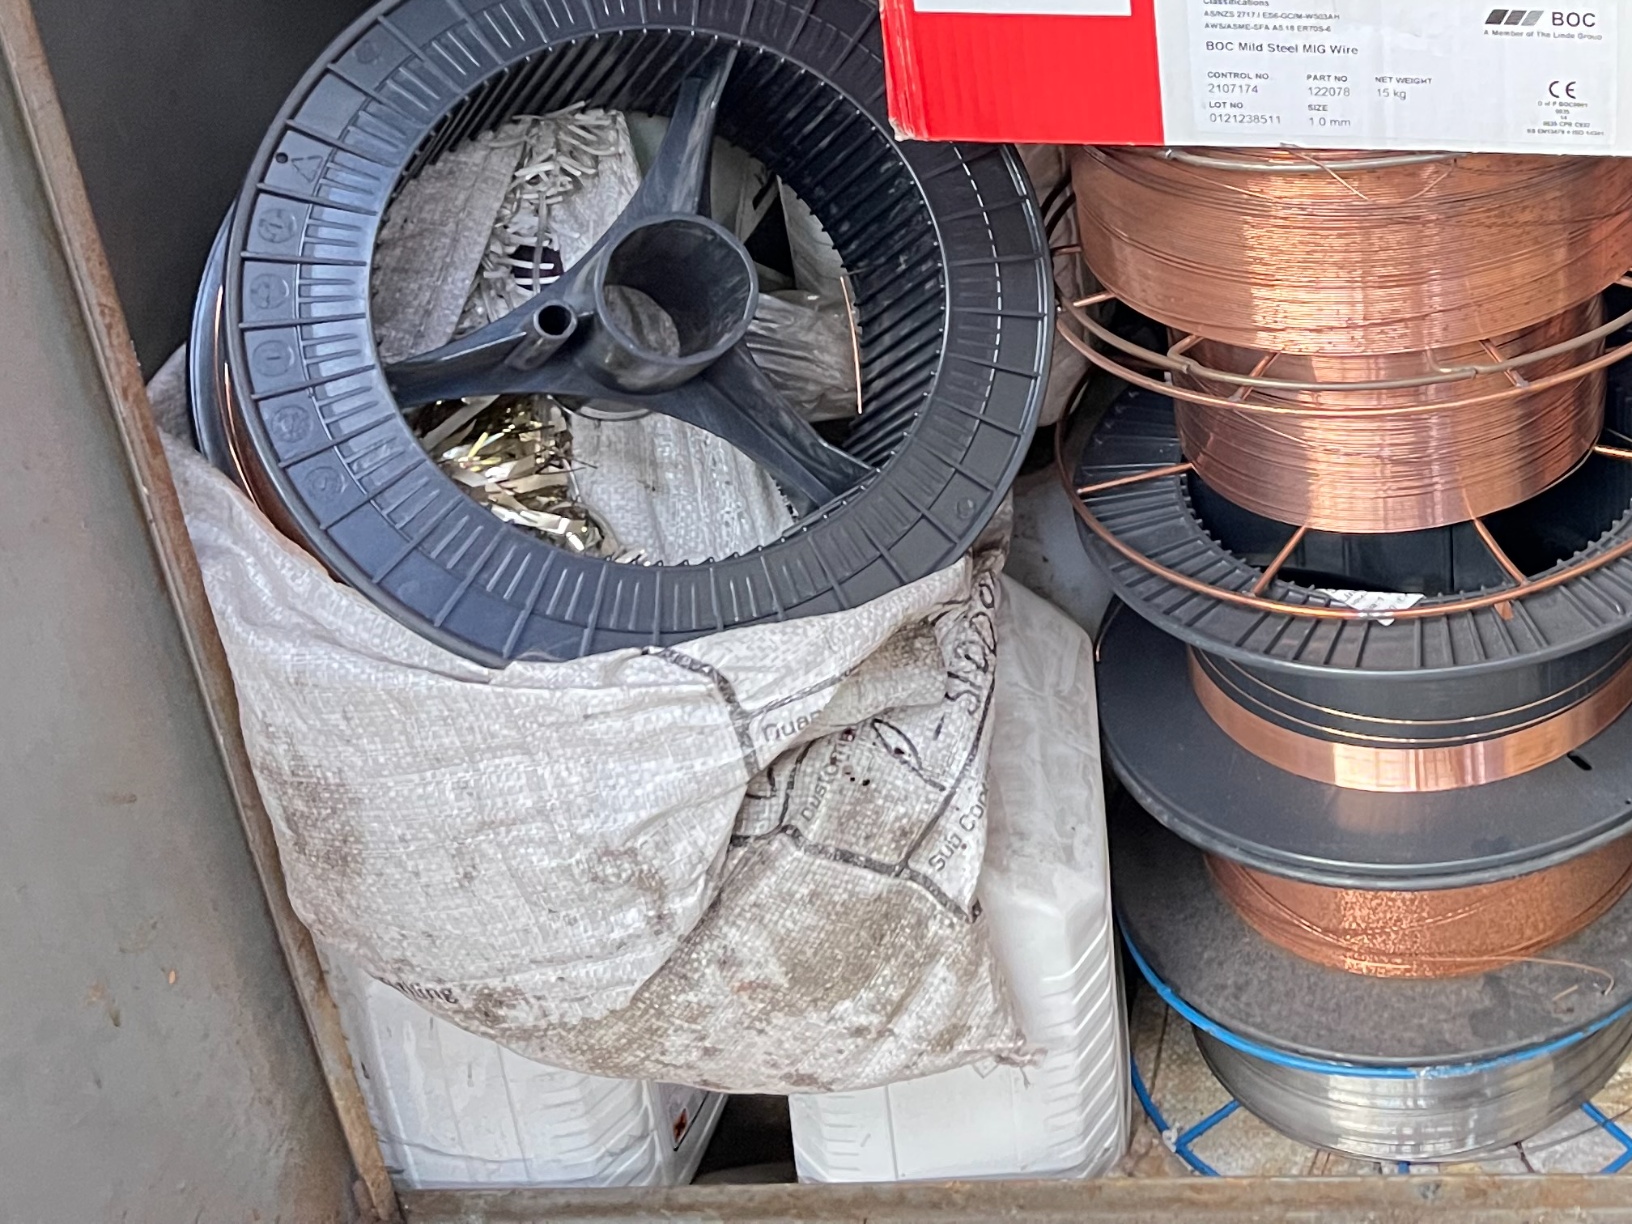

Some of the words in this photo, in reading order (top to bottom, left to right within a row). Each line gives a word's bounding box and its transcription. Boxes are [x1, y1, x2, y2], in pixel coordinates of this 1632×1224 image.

[1552, 12, 1595, 27] BOC
[1206, 41, 1233, 51] BOC
[1239, 42, 1263, 52] Mild
[1267, 43, 1298, 53] Steel
[1303, 44, 1326, 54] MIG
[1330, 45, 1358, 54] Wire
[1207, 71, 1253, 80] CONTROL
[1208, 83, 1258, 94] 2107174
[1308, 87, 1350, 97] 122078
[1377, 88, 1390, 97] 15
[1393, 90, 1406, 100] kg
[1209, 101, 1227, 109] LOT
[1308, 104, 1328, 112] SIZE
[1210, 113, 1280, 124] 0121238511
[928, 833, 962, 872] Sub
